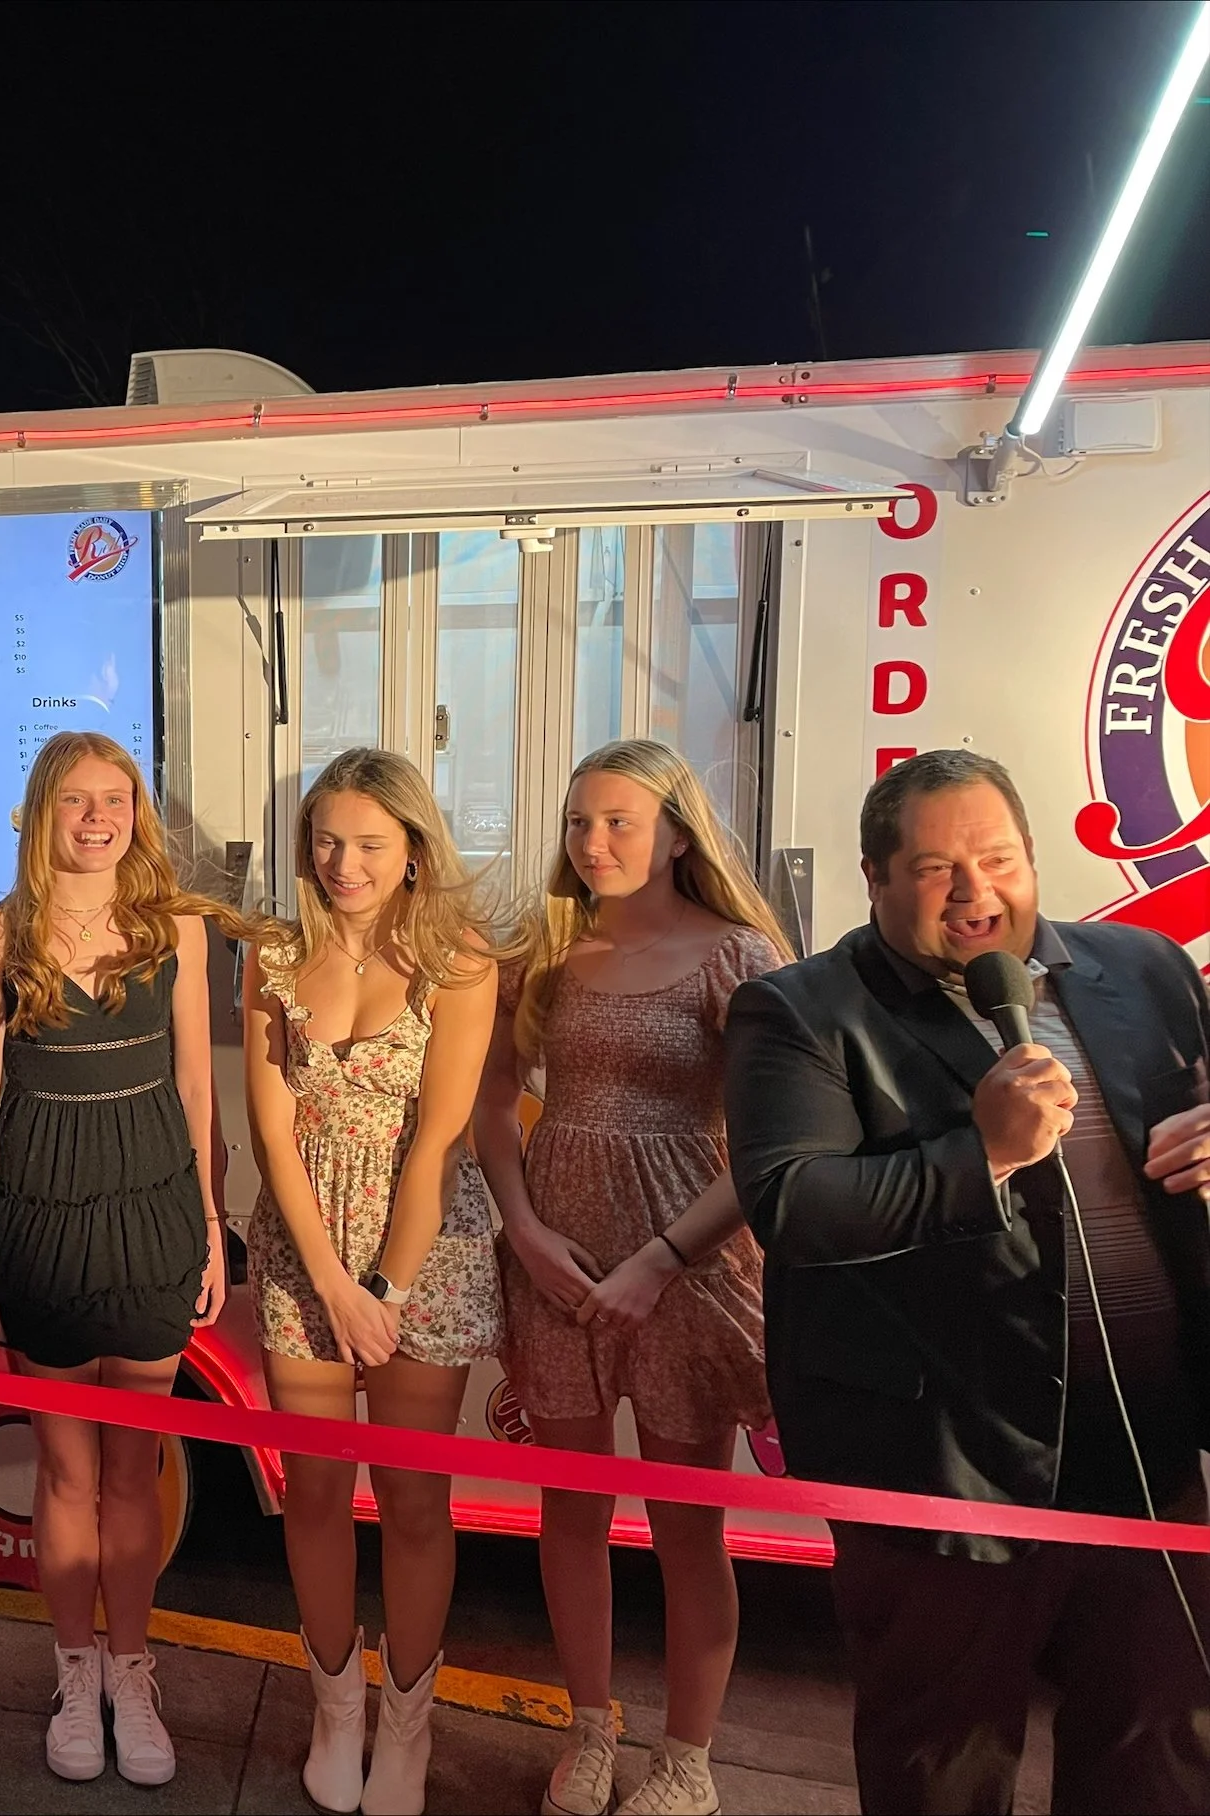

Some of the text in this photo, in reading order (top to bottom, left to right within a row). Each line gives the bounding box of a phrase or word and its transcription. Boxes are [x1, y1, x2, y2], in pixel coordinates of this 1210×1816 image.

[16, 627, 25, 635] $5
[1104, 535, 1210, 735] FRESH
[16, 640, 26, 648] $2
[14, 653, 27, 661] $10
[32, 697, 77, 708] Drinks
[18, 724, 27, 732] $1
[33, 723, 59, 731] Coffee
[133, 735, 142, 743] $2
[19, 751, 27, 759] $1
[133, 748, 141, 756] $1
[21, 764, 29, 772] $1
